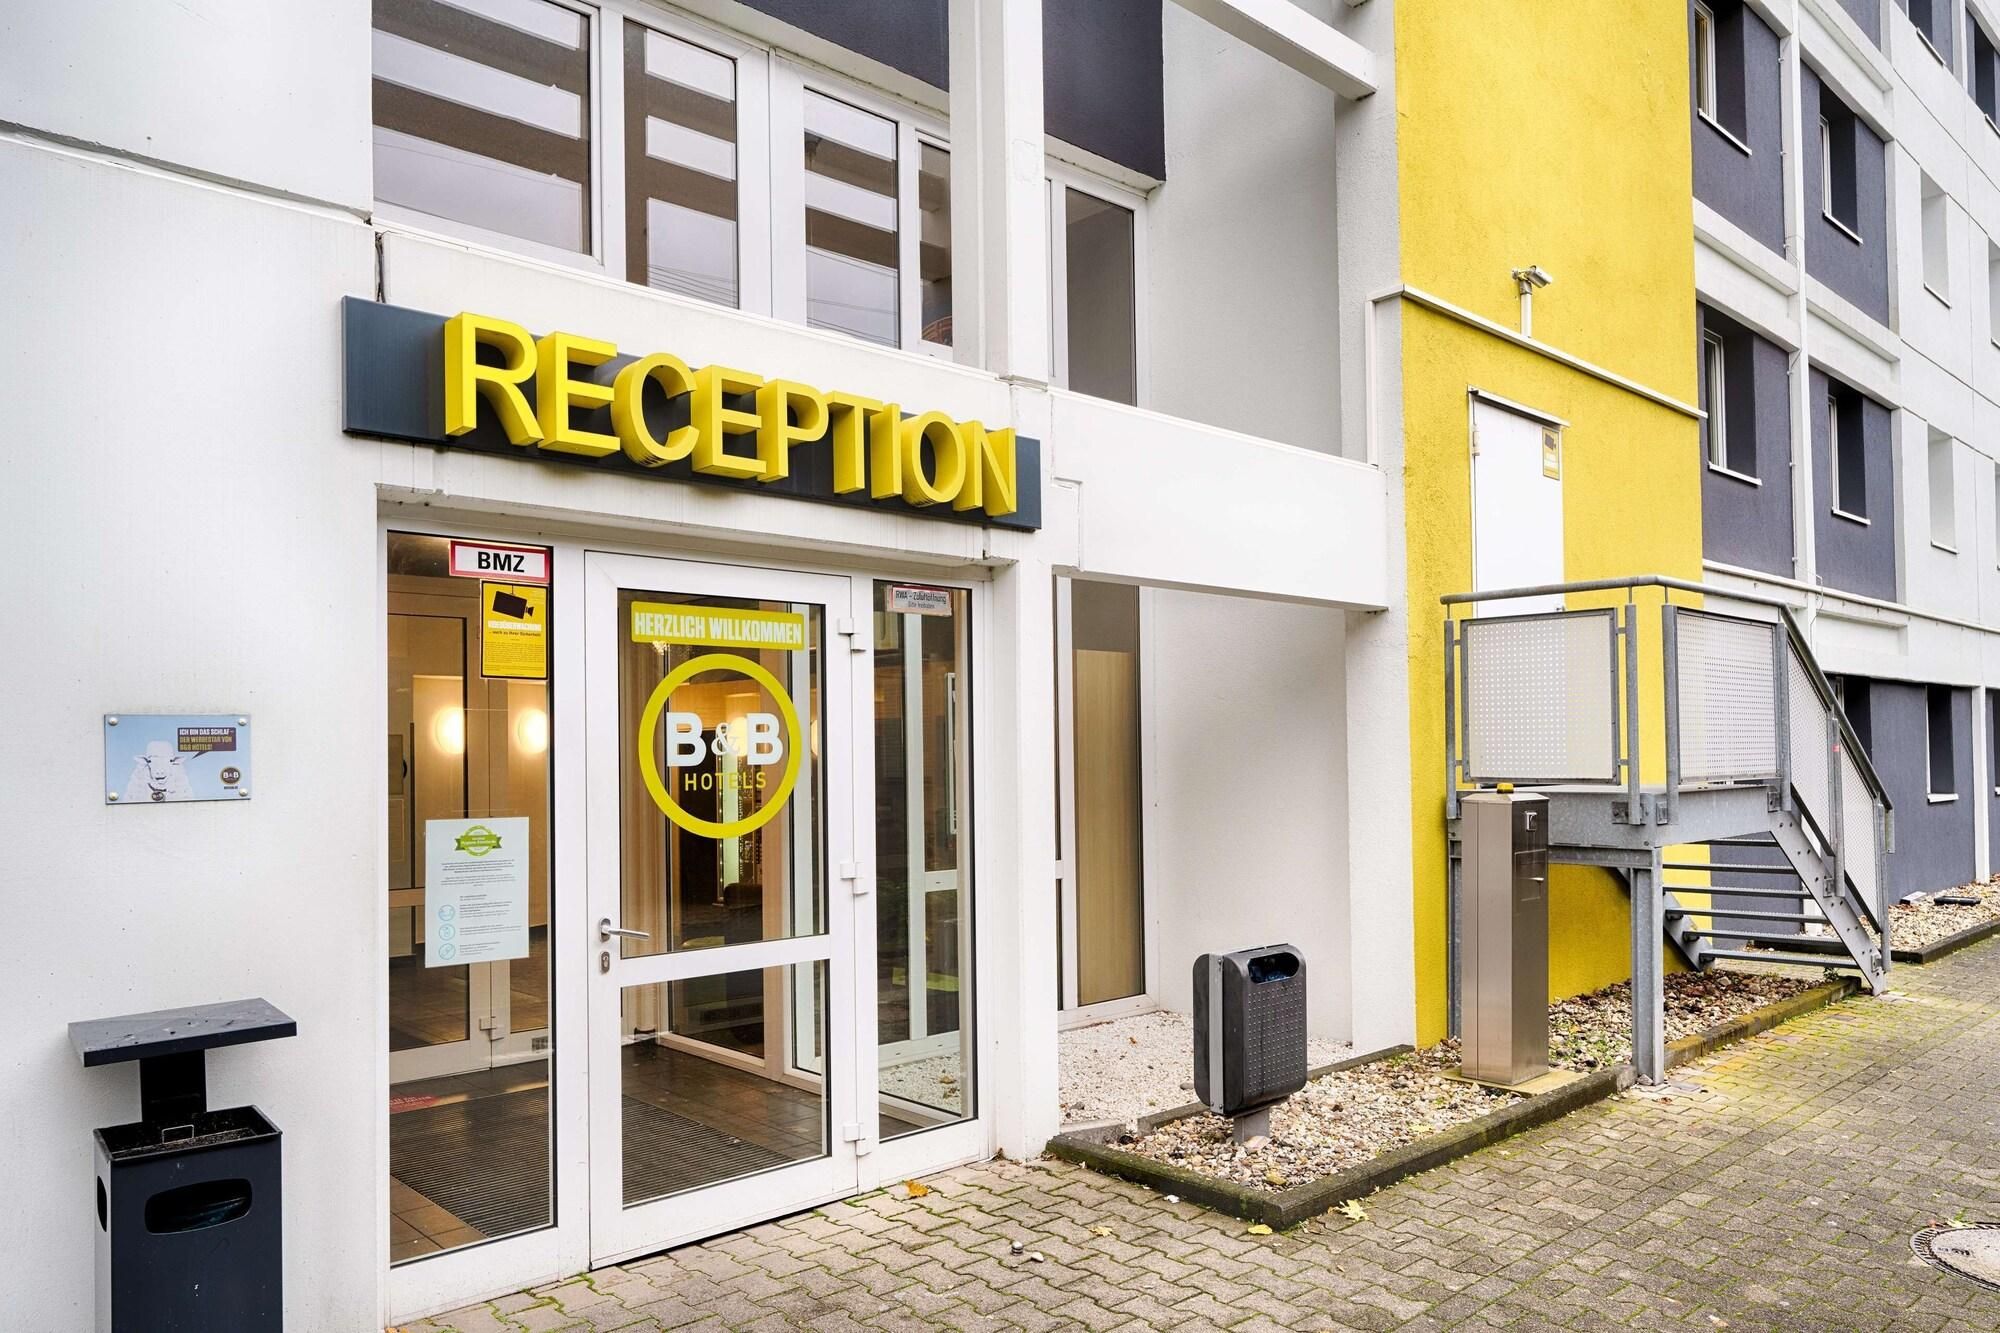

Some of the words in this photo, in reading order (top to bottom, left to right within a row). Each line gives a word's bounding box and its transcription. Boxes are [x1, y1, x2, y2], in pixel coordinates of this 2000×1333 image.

[445, 312, 1016, 516] RECEPTION
[477, 551, 525, 573] BMZ
[634, 612, 706, 639] HERZLICH
[709, 617, 803, 644] WILLKOMMEN
[666, 711, 784, 767] B&B
[685, 771, 767, 791] HOTELS
